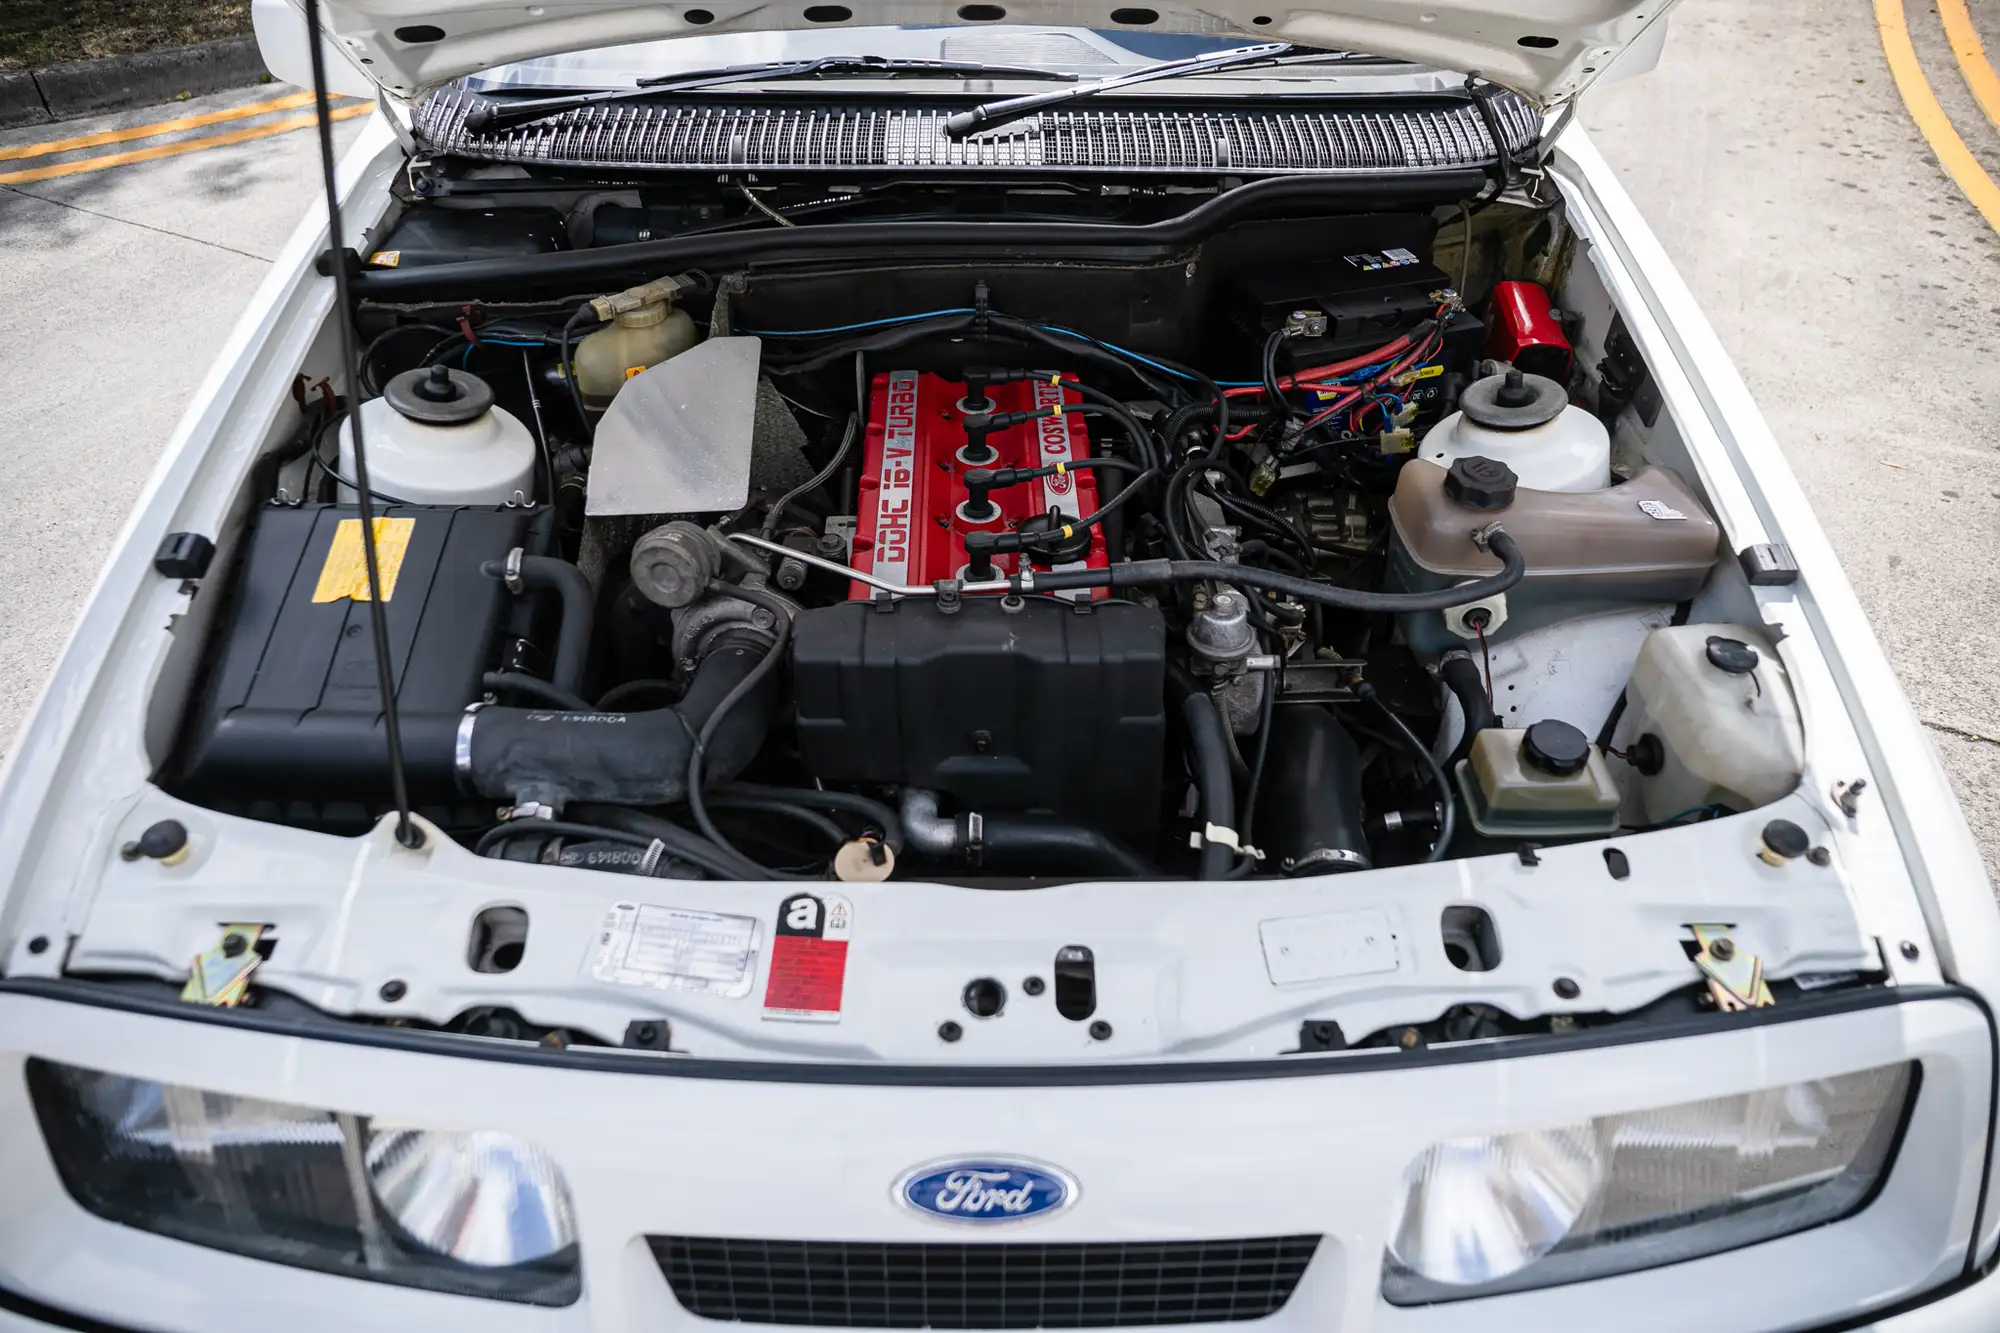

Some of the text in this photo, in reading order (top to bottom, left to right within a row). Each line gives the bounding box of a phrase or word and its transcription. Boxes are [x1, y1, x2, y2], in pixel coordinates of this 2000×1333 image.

[877, 379, 916, 562] DOHC 16-V TURBO
[785, 897, 819, 931] a
[935, 1169, 1035, 1213] Ford
